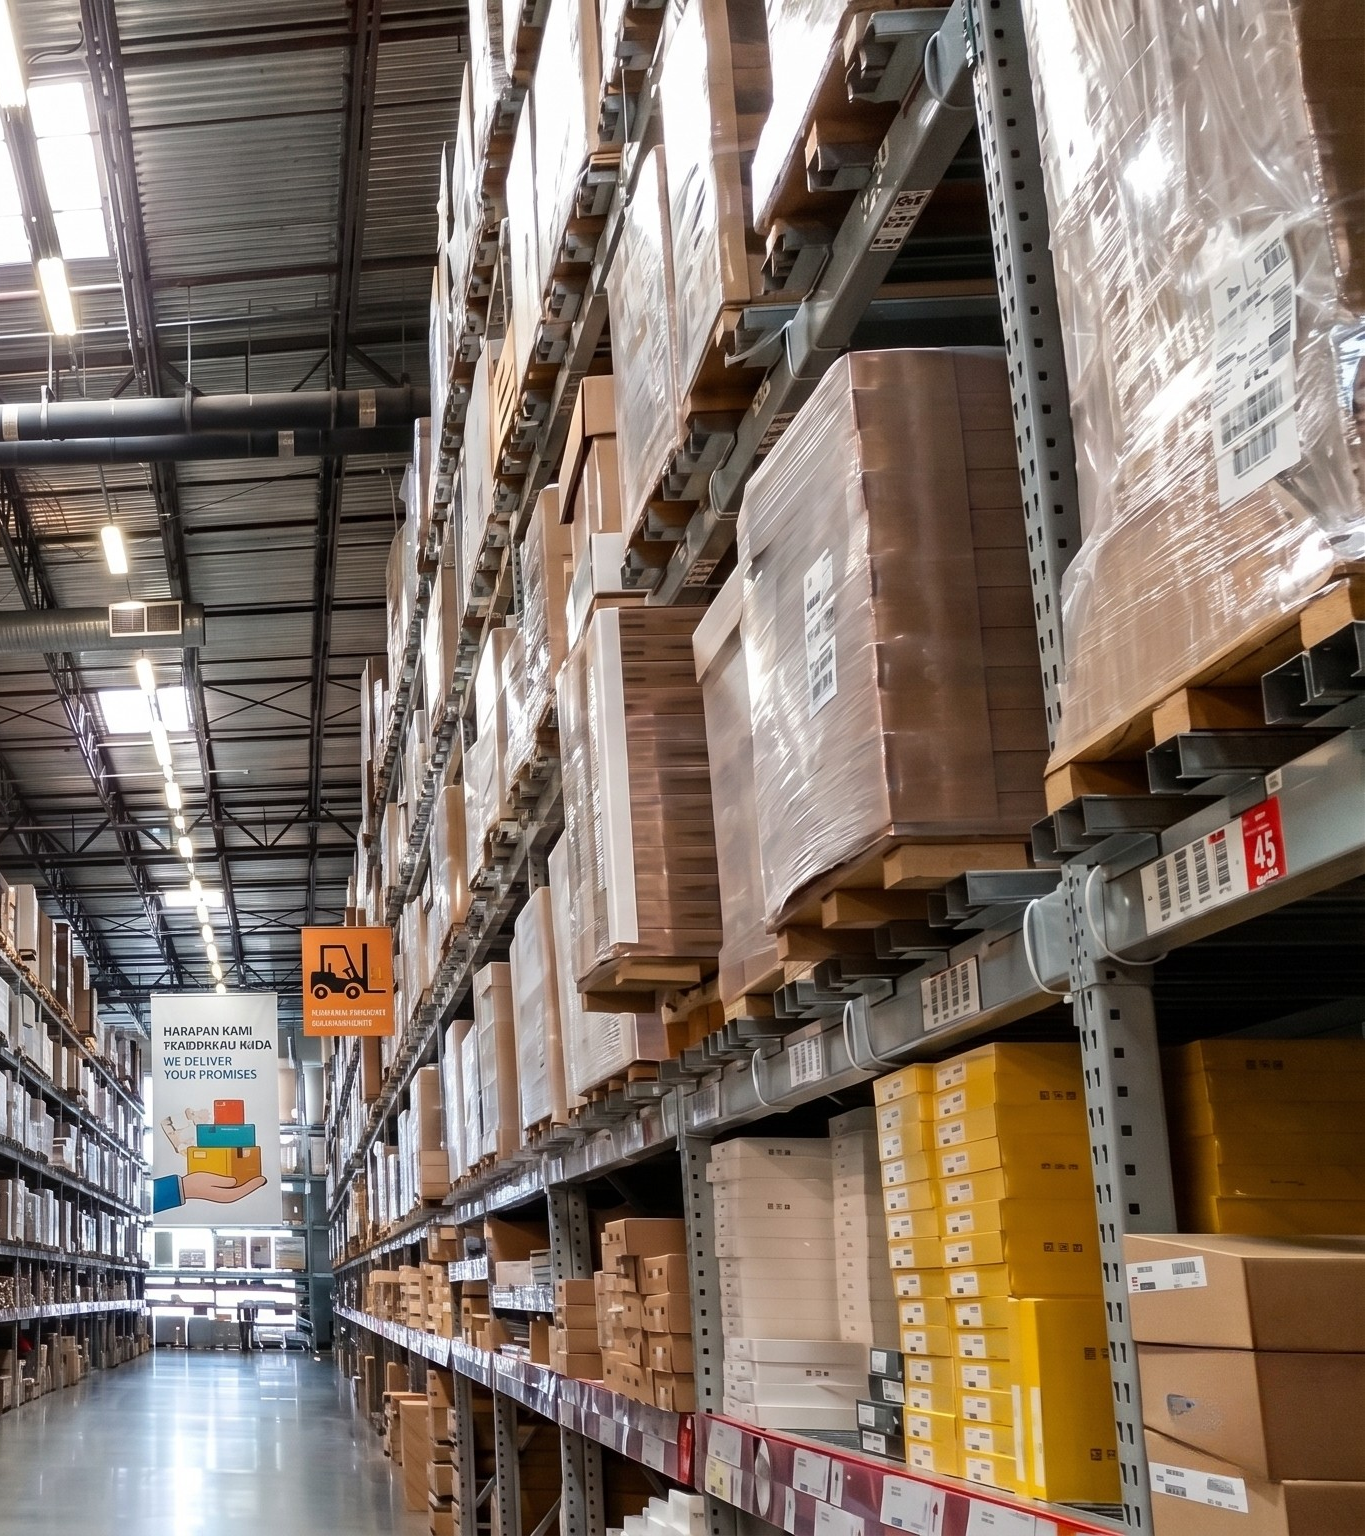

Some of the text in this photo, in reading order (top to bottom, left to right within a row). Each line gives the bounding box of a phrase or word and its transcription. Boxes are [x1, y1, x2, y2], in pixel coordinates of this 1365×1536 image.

[1254, 829, 1276, 869] 45
[163, 1026, 252, 1036] HARAPAN KAMI
[163, 1056, 232, 1066] WE DELIVER
[164, 1069, 257, 1080] YOUR PROMISES
